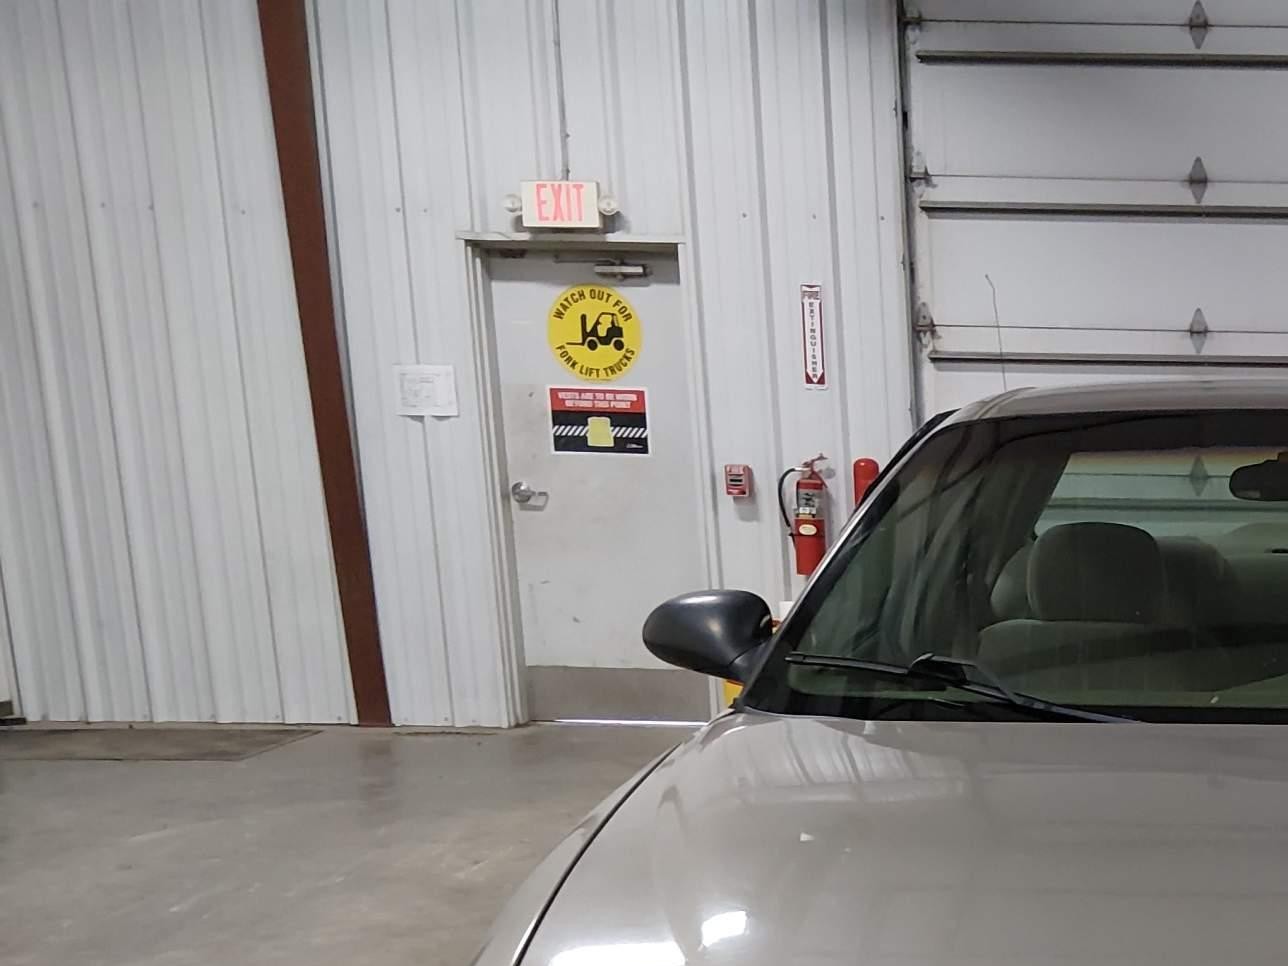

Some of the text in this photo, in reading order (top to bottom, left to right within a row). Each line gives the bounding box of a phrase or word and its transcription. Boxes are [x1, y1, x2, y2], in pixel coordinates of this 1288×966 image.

[536, 183, 585, 222] EXIT
[553, 288, 633, 322] WATCH OUT FOR
[808, 301, 818, 379] EXTINGUISHER
[555, 344, 636, 378] FORK LIFT TRUCKS
